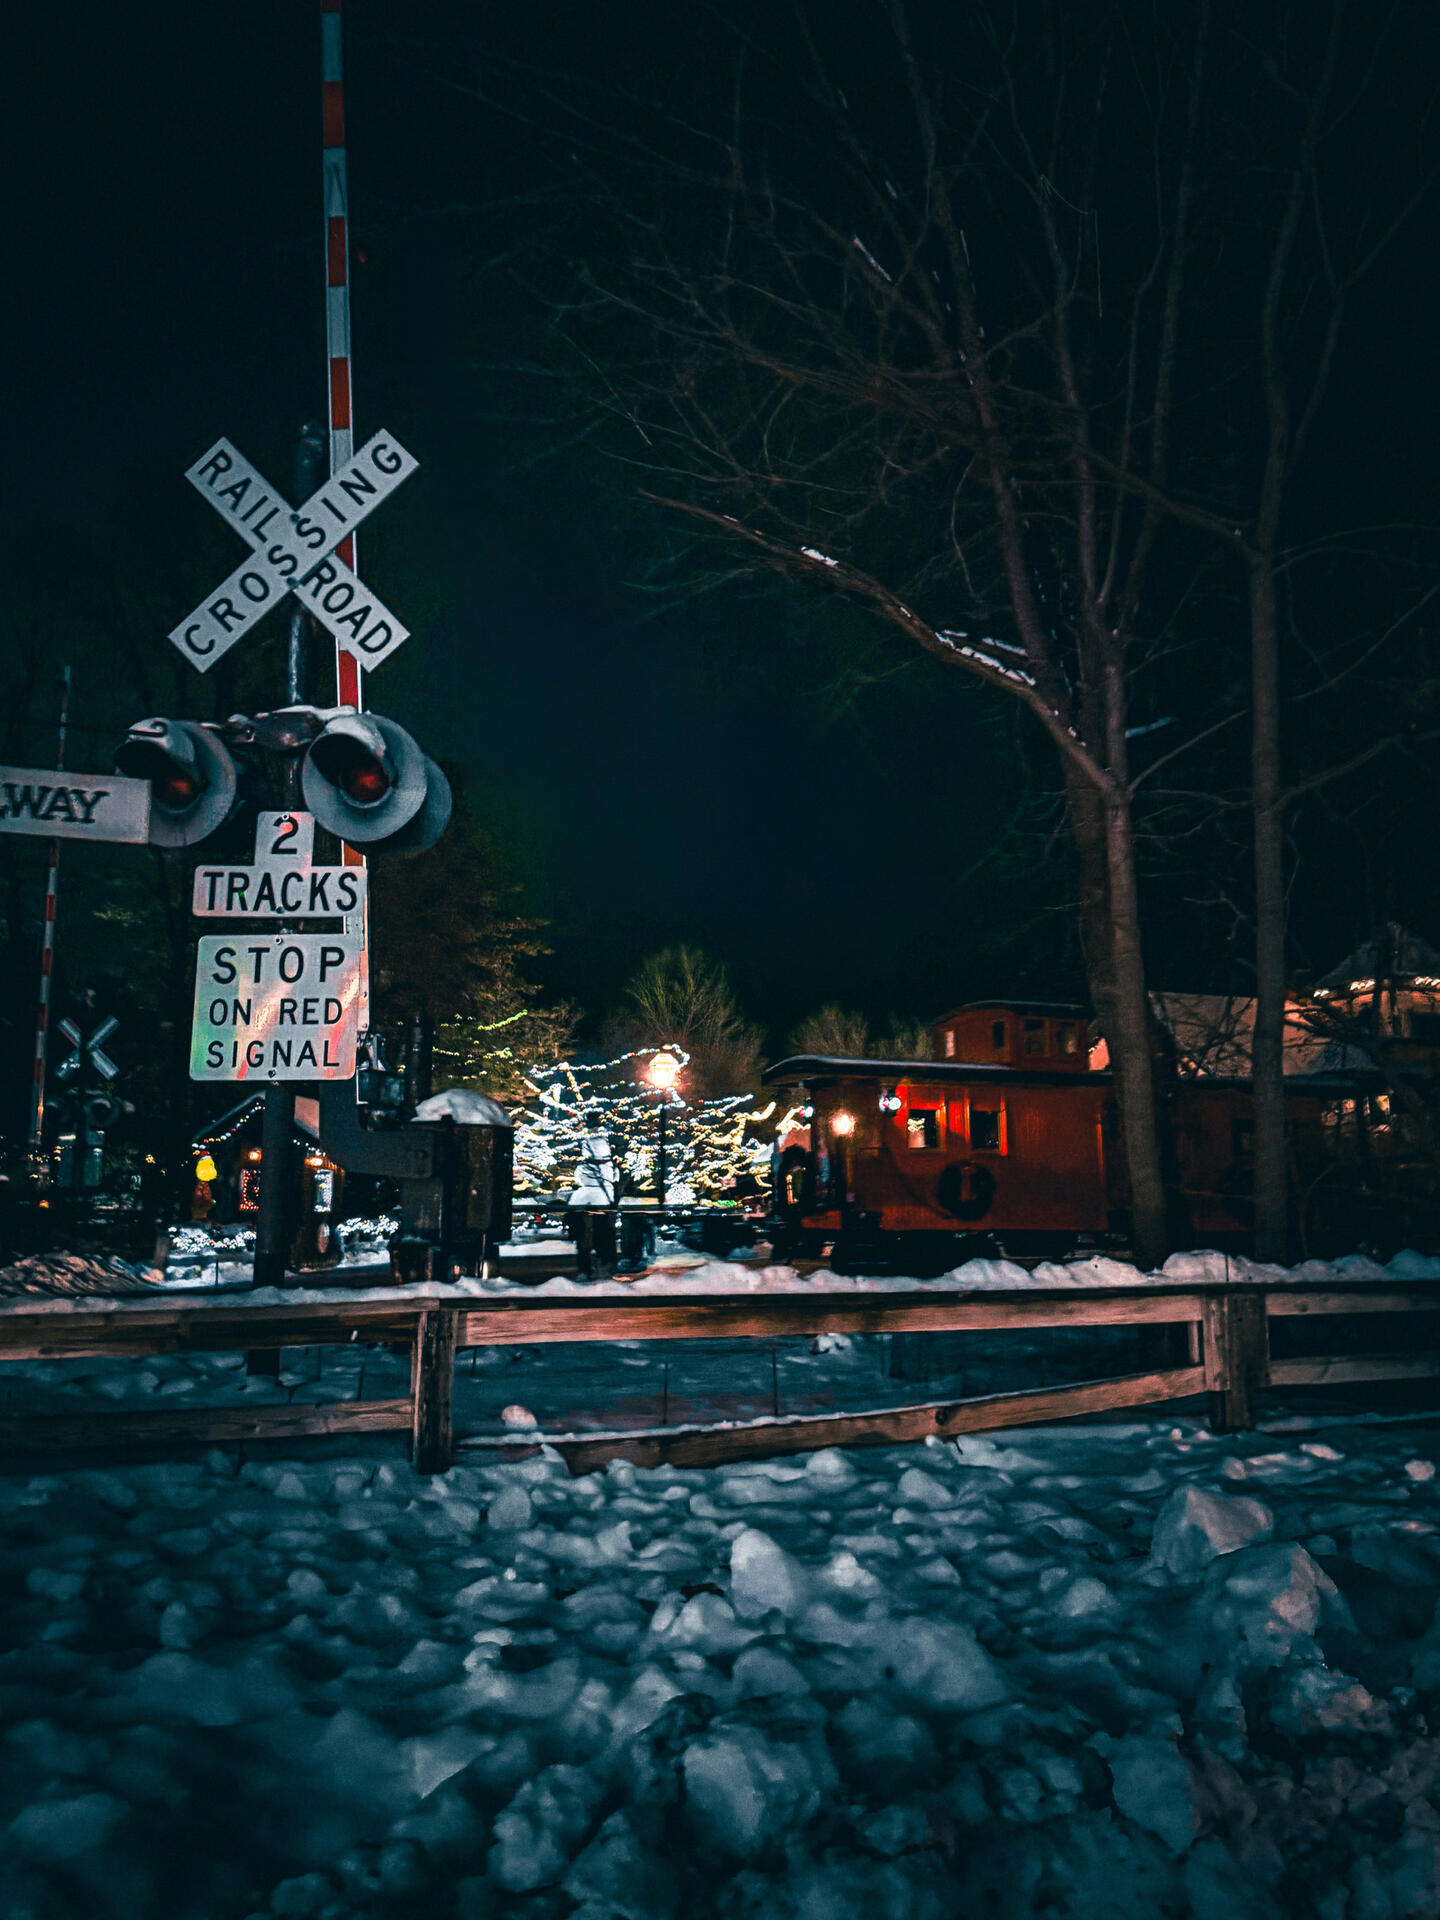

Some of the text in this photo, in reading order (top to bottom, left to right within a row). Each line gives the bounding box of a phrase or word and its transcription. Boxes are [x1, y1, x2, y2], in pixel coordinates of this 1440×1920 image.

[184, 443, 402, 655] CROSSING
[198, 449, 392, 654] RAIL ROAD
[0, 783, 110, 824] WAY
[271, 816, 298, 855] 2
[202, 871, 358, 912] TRACKS
[212, 946, 345, 985] STOP
[208, 997, 343, 1026] ON RED
[205, 1040, 341, 1068] SIGNAL
